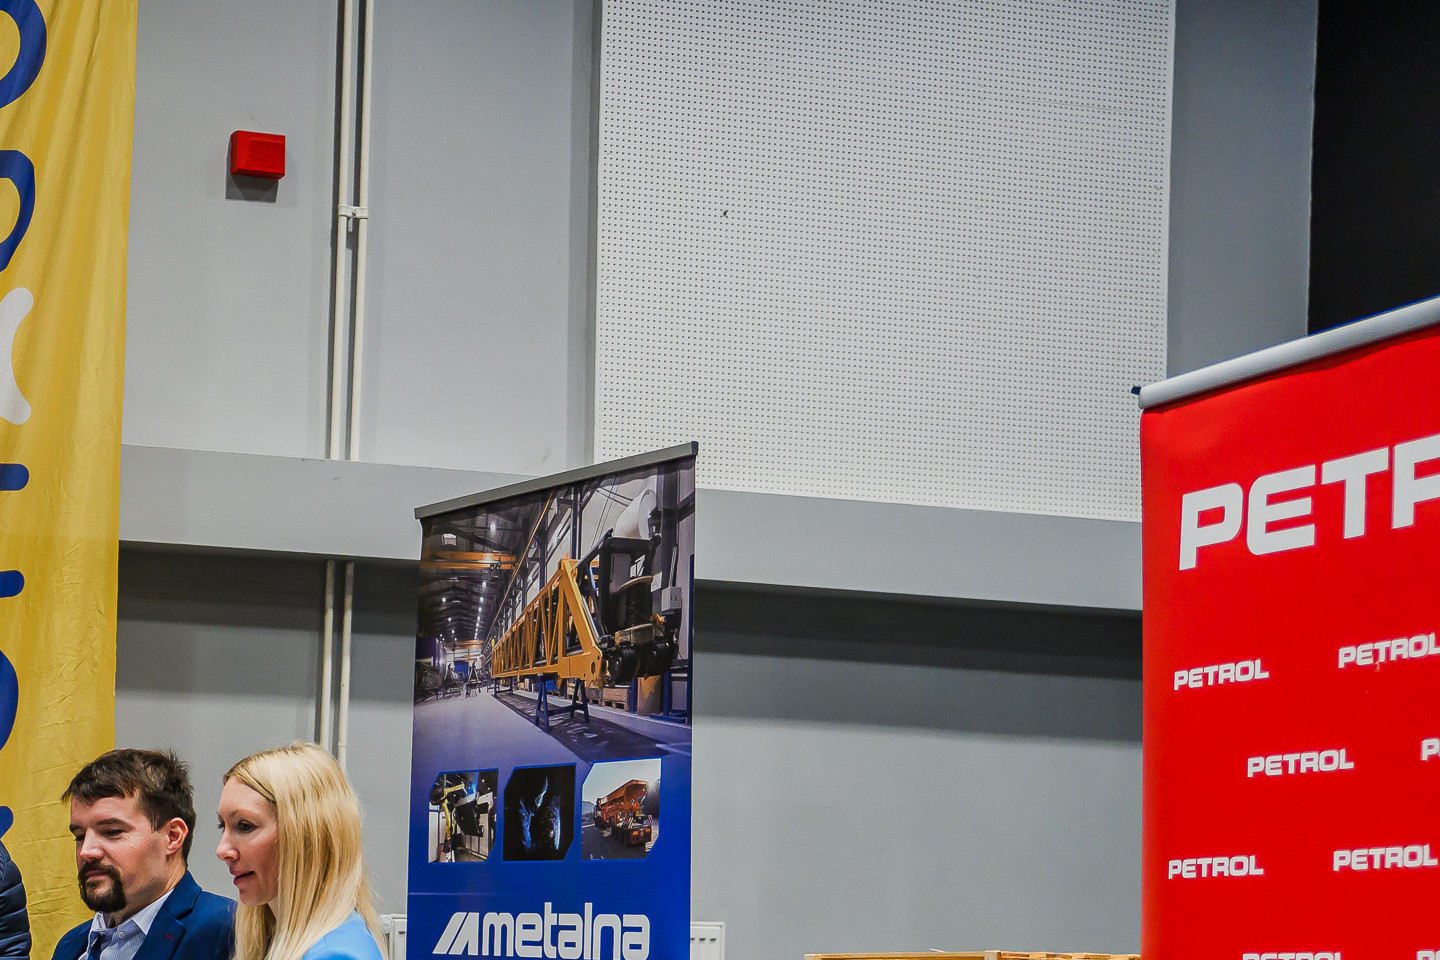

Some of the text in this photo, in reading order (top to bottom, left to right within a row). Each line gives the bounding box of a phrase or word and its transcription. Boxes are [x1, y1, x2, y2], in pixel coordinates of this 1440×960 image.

[1179, 433, 1440, 571] PETR
[1338, 632, 1440, 669] PETROL
[1174, 659, 1270, 691] PETROL
[1247, 749, 1355, 778] PETROL
[1168, 855, 1264, 879] PETROL
[1333, 844, 1438, 871] PETROL
